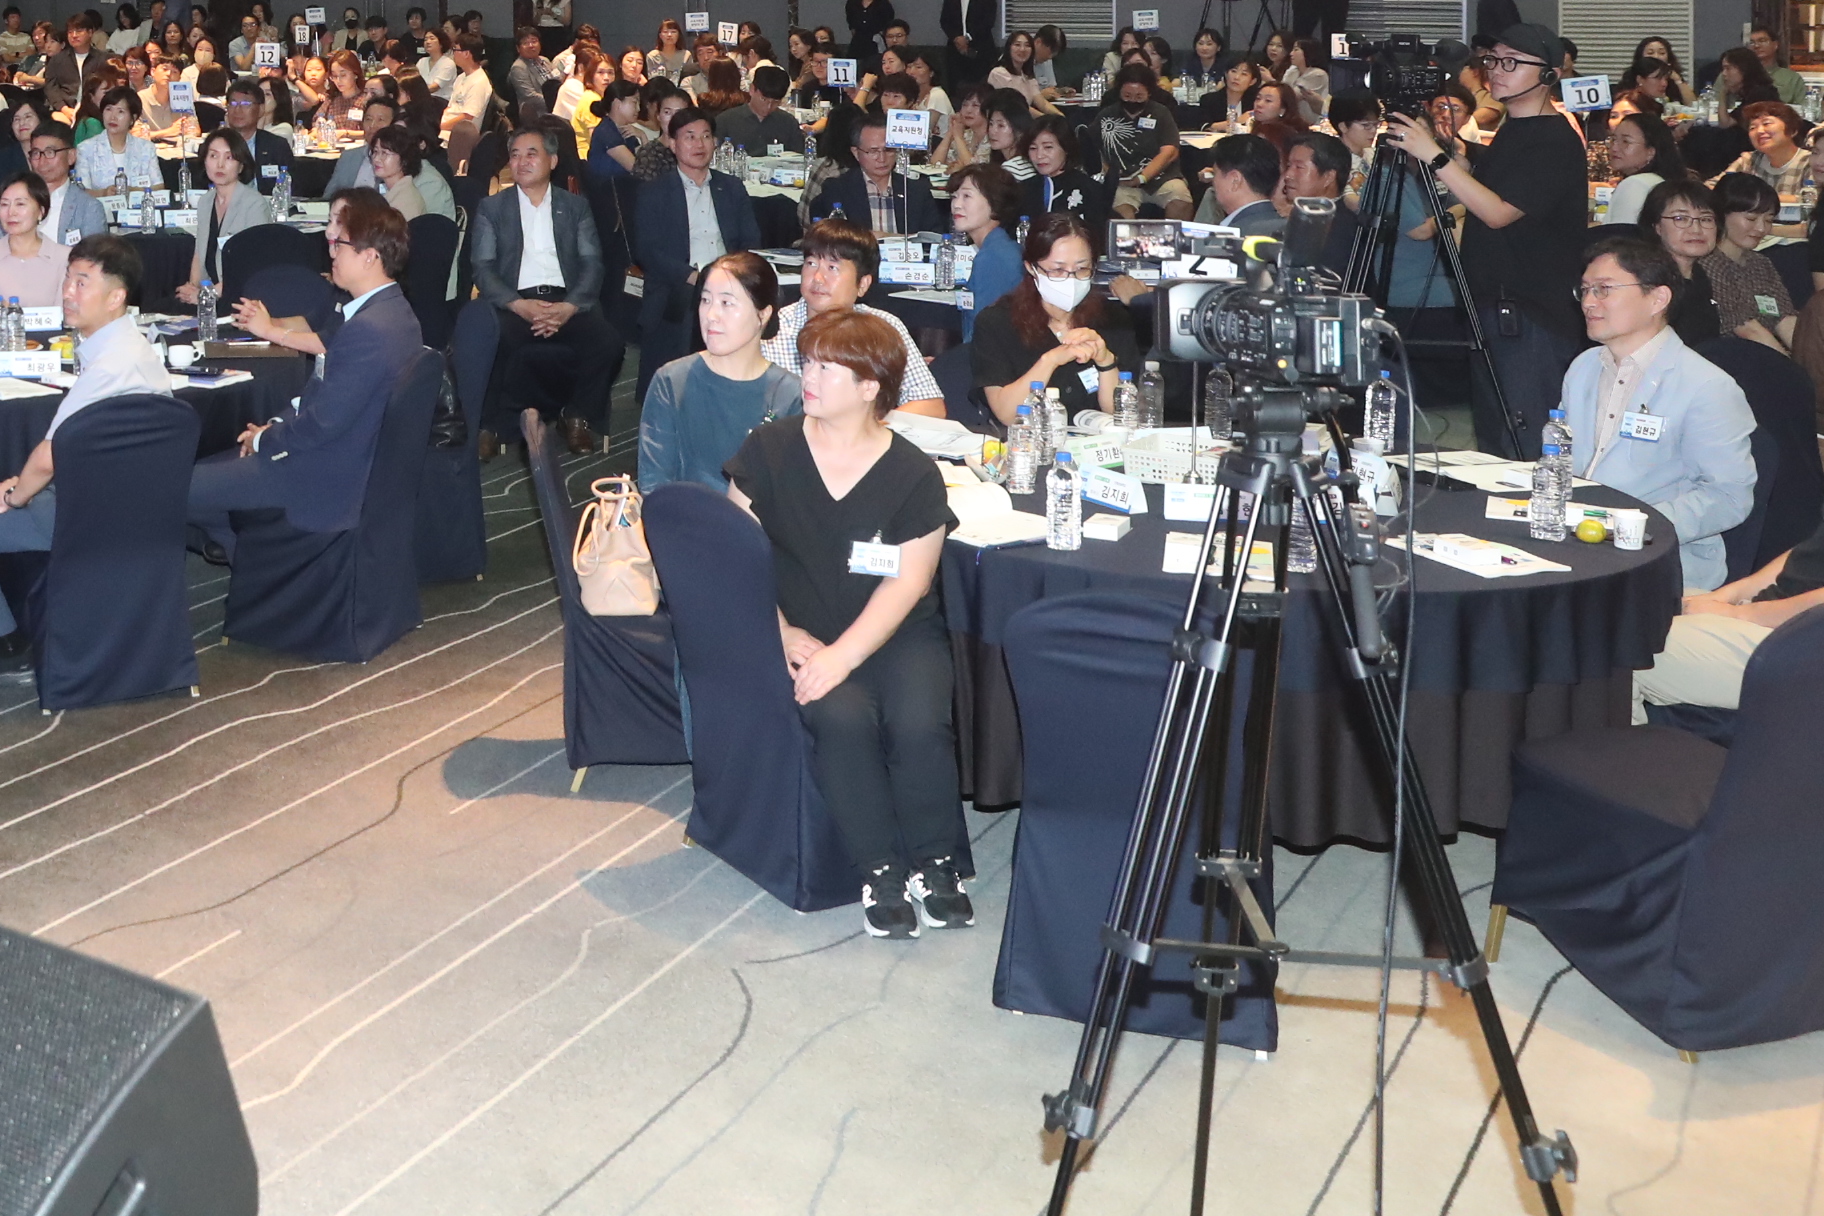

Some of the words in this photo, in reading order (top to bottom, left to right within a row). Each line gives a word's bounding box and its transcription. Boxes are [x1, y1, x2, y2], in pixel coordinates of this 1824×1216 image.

[298, 31, 306, 42] 18
[722, 30, 733, 42] 17
[260, 51, 274, 63] 12
[834, 68, 850, 83] 11
[1574, 87, 1600, 105] 10
[891, 124, 923, 136] 교육지원청
[1101, 485, 1129, 505] 김지희
